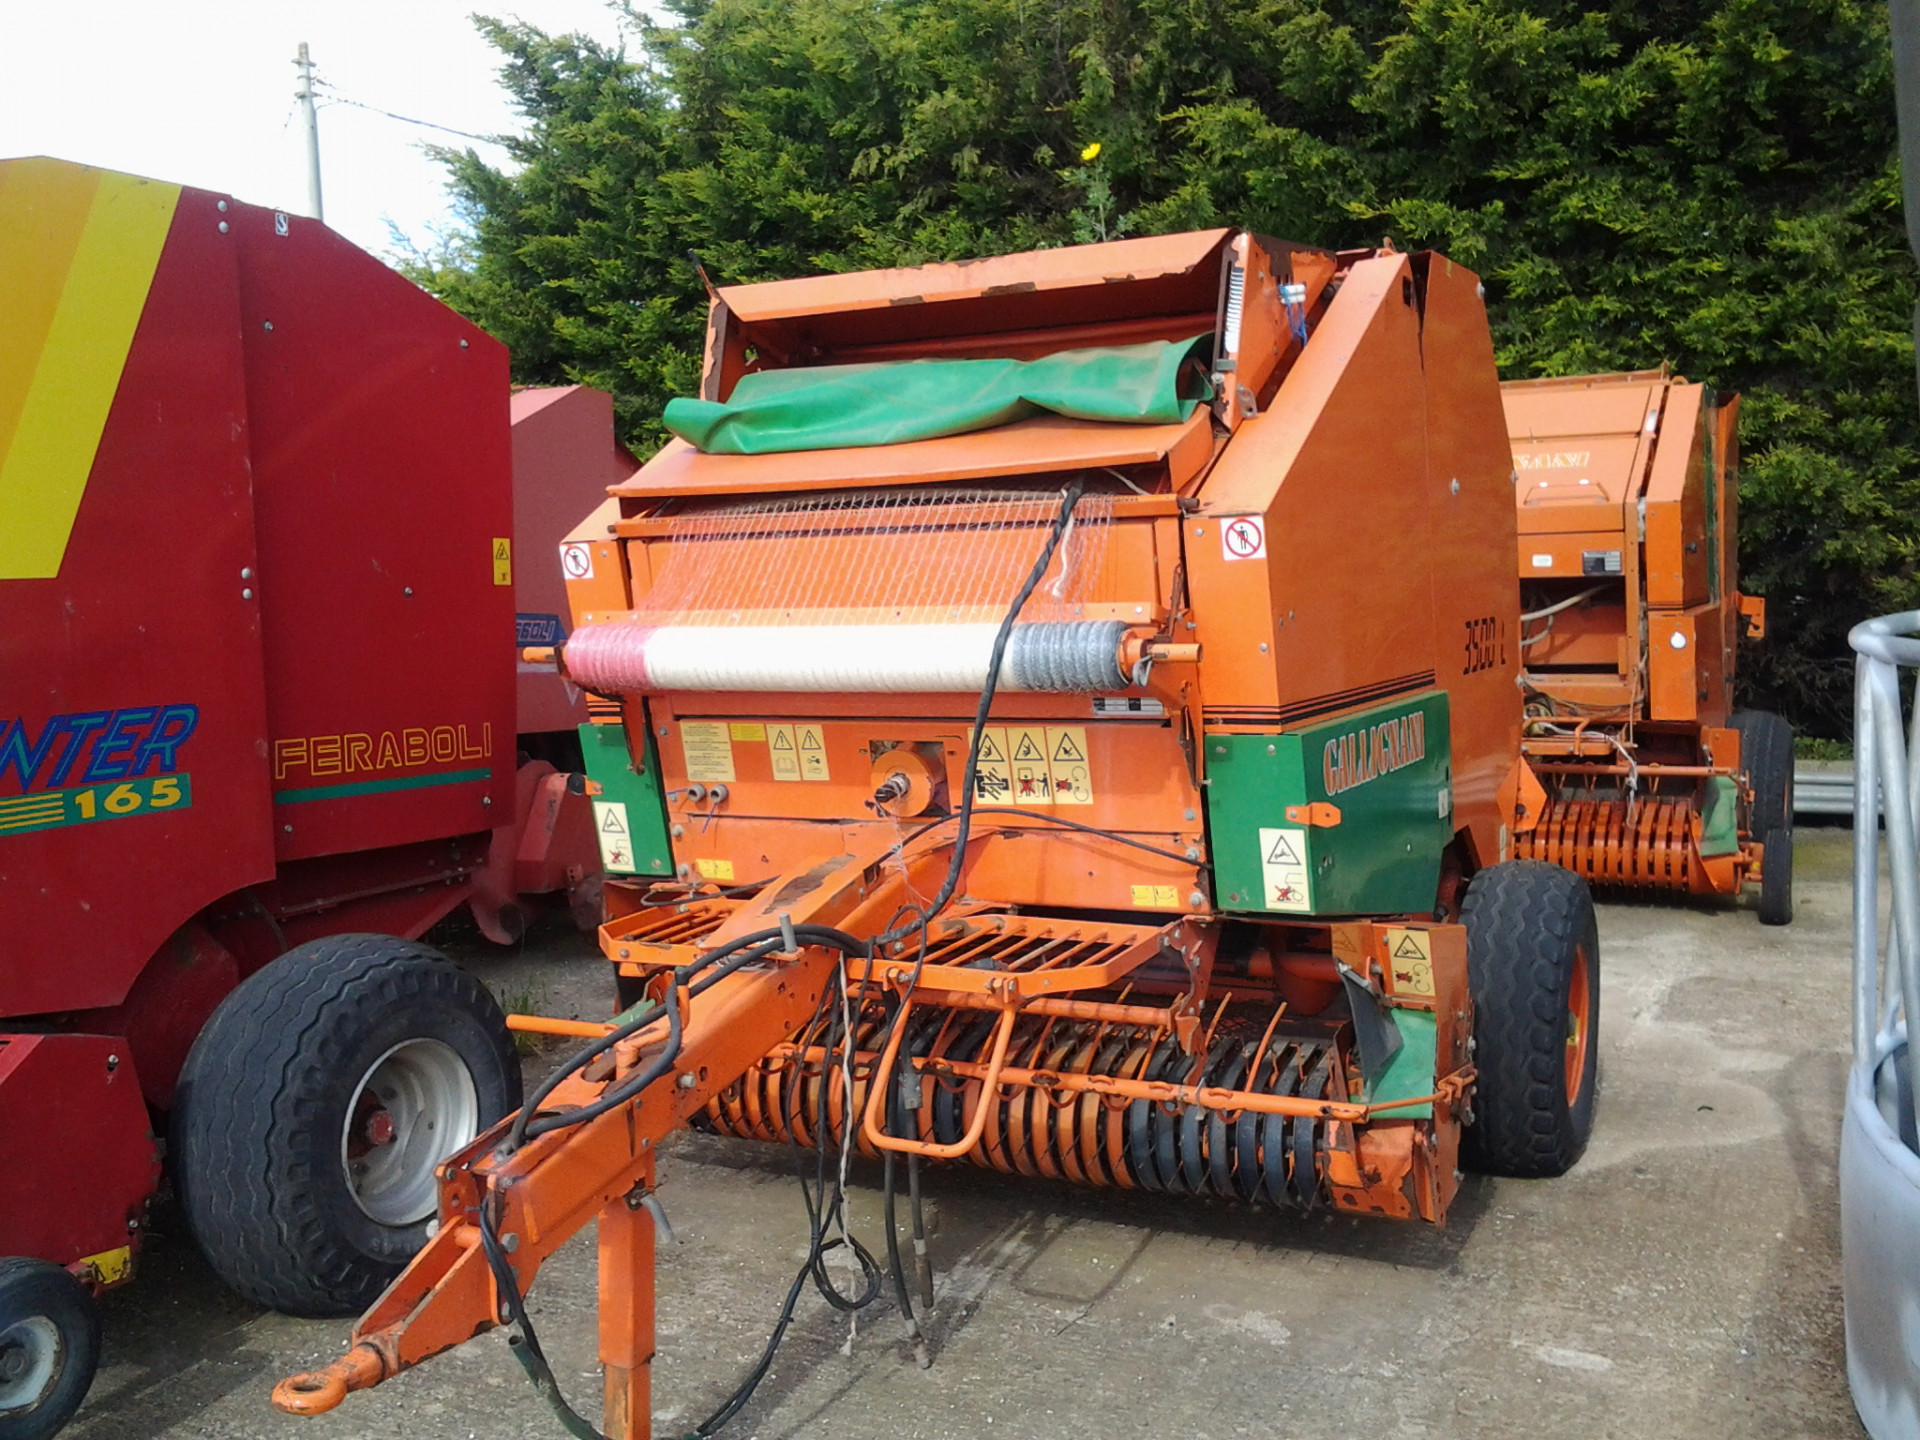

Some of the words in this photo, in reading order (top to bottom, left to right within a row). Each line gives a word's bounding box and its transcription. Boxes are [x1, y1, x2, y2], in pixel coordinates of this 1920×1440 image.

[275, 722, 492, 780] FERABOLI
[1323, 710, 1425, 797] GALLIGNANI
[75, 778, 182, 819] 165
